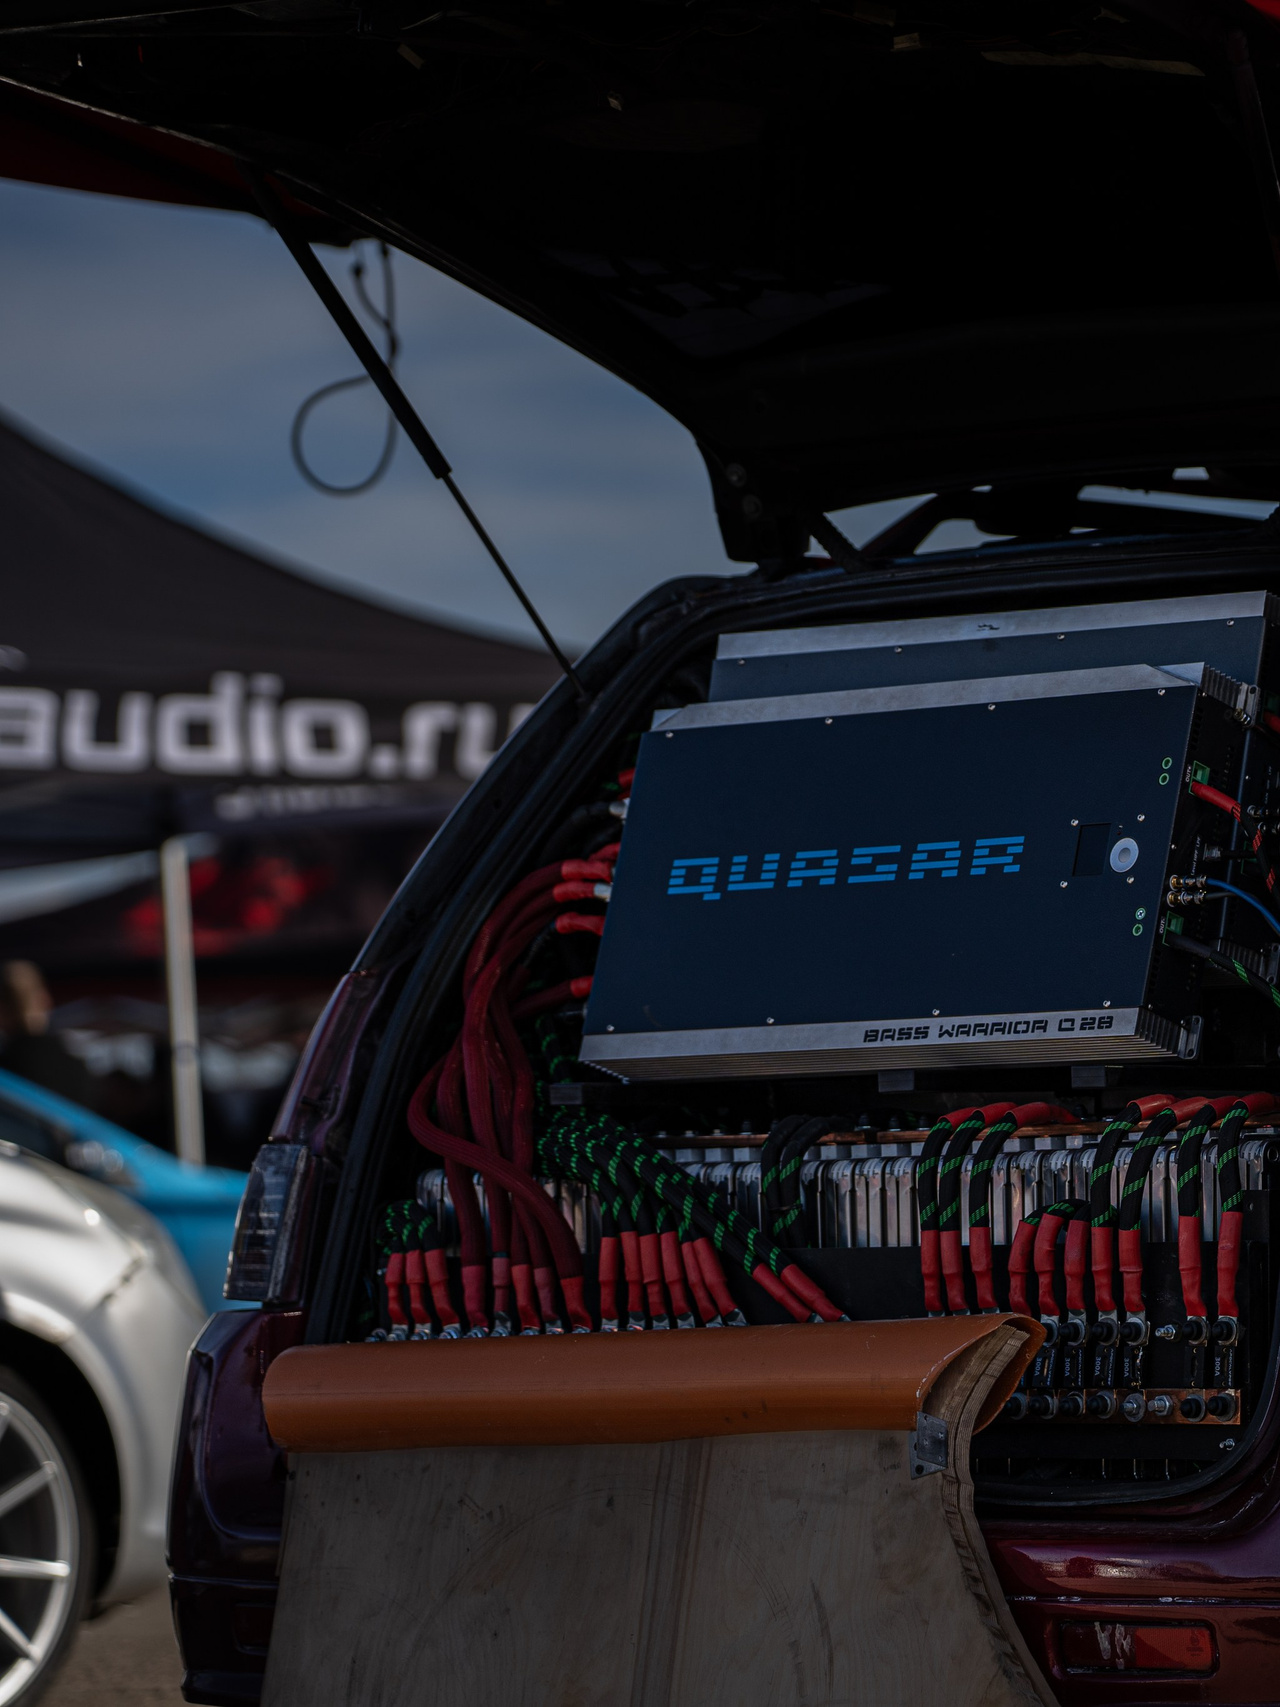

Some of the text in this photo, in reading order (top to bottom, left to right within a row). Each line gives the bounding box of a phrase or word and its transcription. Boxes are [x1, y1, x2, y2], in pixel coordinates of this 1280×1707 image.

[666, 835, 1025, 901] QUASAR
[863, 1026, 930, 1043] BASS
[938, 1019, 1048, 1038] WARRIOR
[1034, 1357, 1043, 1376] 300A
[1094, 1356, 1102, 1375] 300A
